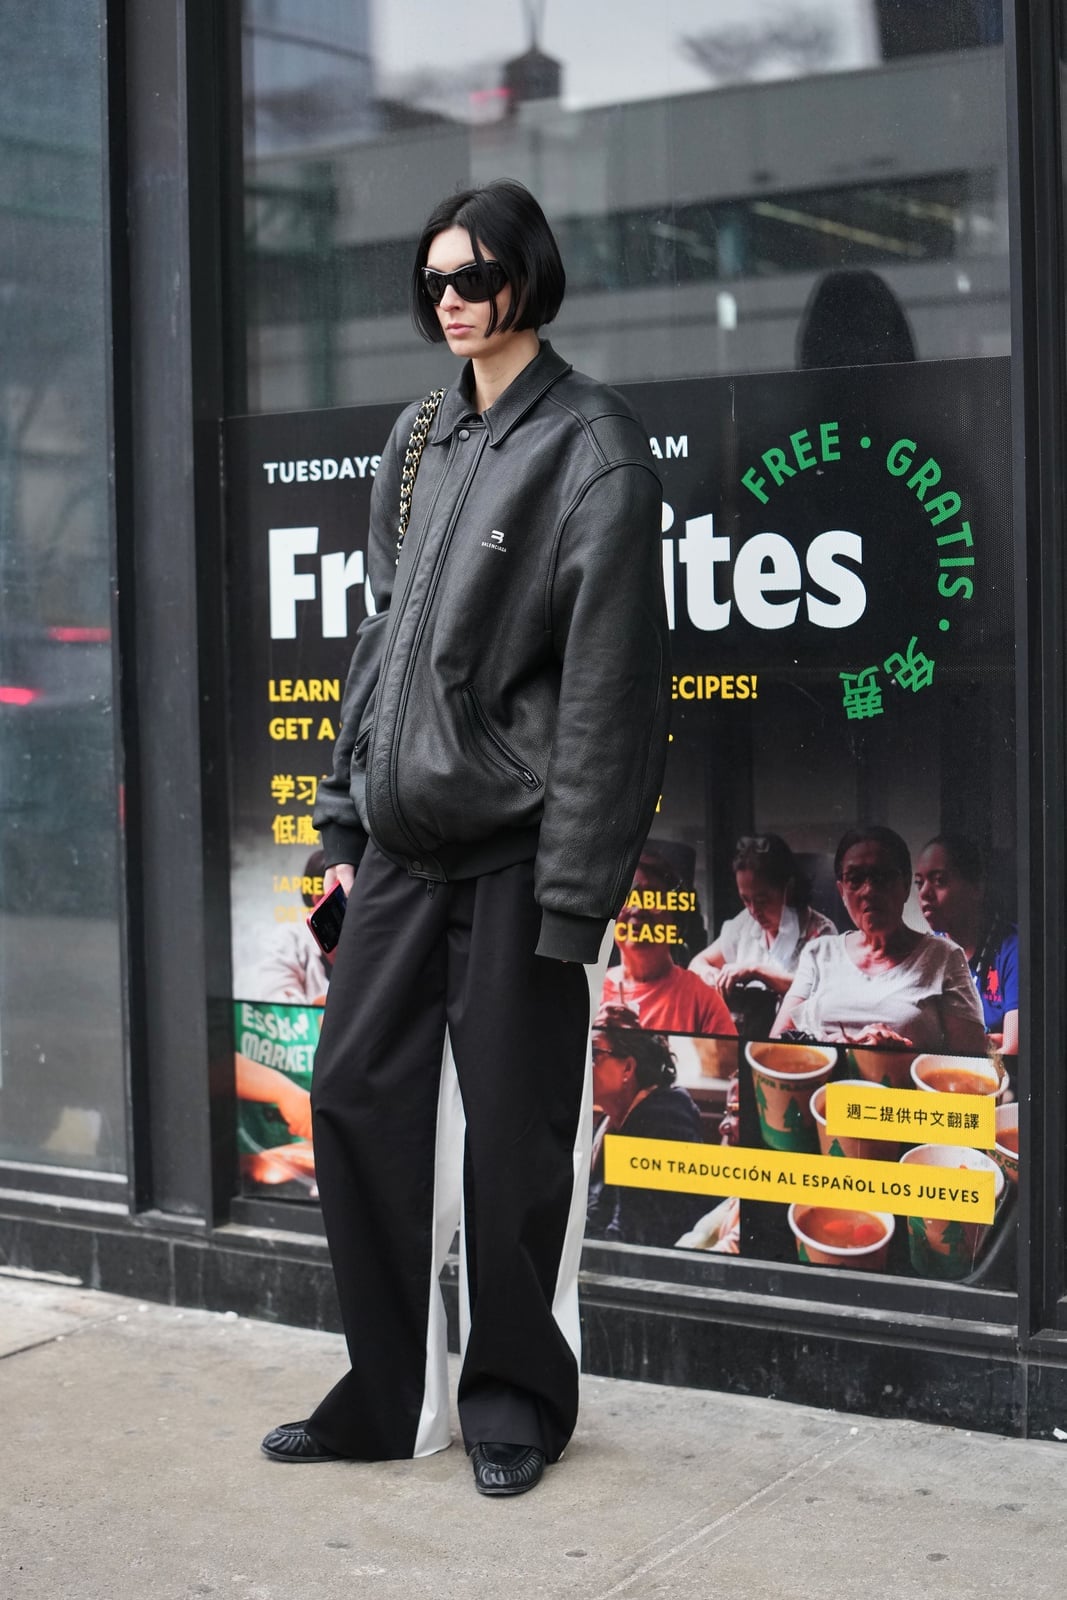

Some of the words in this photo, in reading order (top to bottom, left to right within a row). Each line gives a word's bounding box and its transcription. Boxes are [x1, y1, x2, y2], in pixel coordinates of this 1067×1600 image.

[741, 422, 840, 504] FREE
[887, 438, 974, 600] GRATIS
[269, 526, 377, 639] Fr
[269, 679, 340, 702] LEARN
[839, 636, 935, 719] 免费
[269, 717, 313, 740] GET
[317, 717, 336, 740] A
[271, 774, 327, 805] 学习
[626, 890, 696, 912] ABLES!
[614, 922, 684, 944] CLASE.
[241, 1032, 316, 1073] MARKET
[846, 1103, 979, 1130] 週二提供中文翻譯
[630, 1156, 662, 1171] CON
[667, 1160, 772, 1182] TRADUCCIÓN
[777, 1171, 797, 1185] AL
[802, 1174, 876, 1193] ESPAÑOL
[881, 1182, 912, 1197] LOS
[917, 1185, 980, 1203] JUEVES
